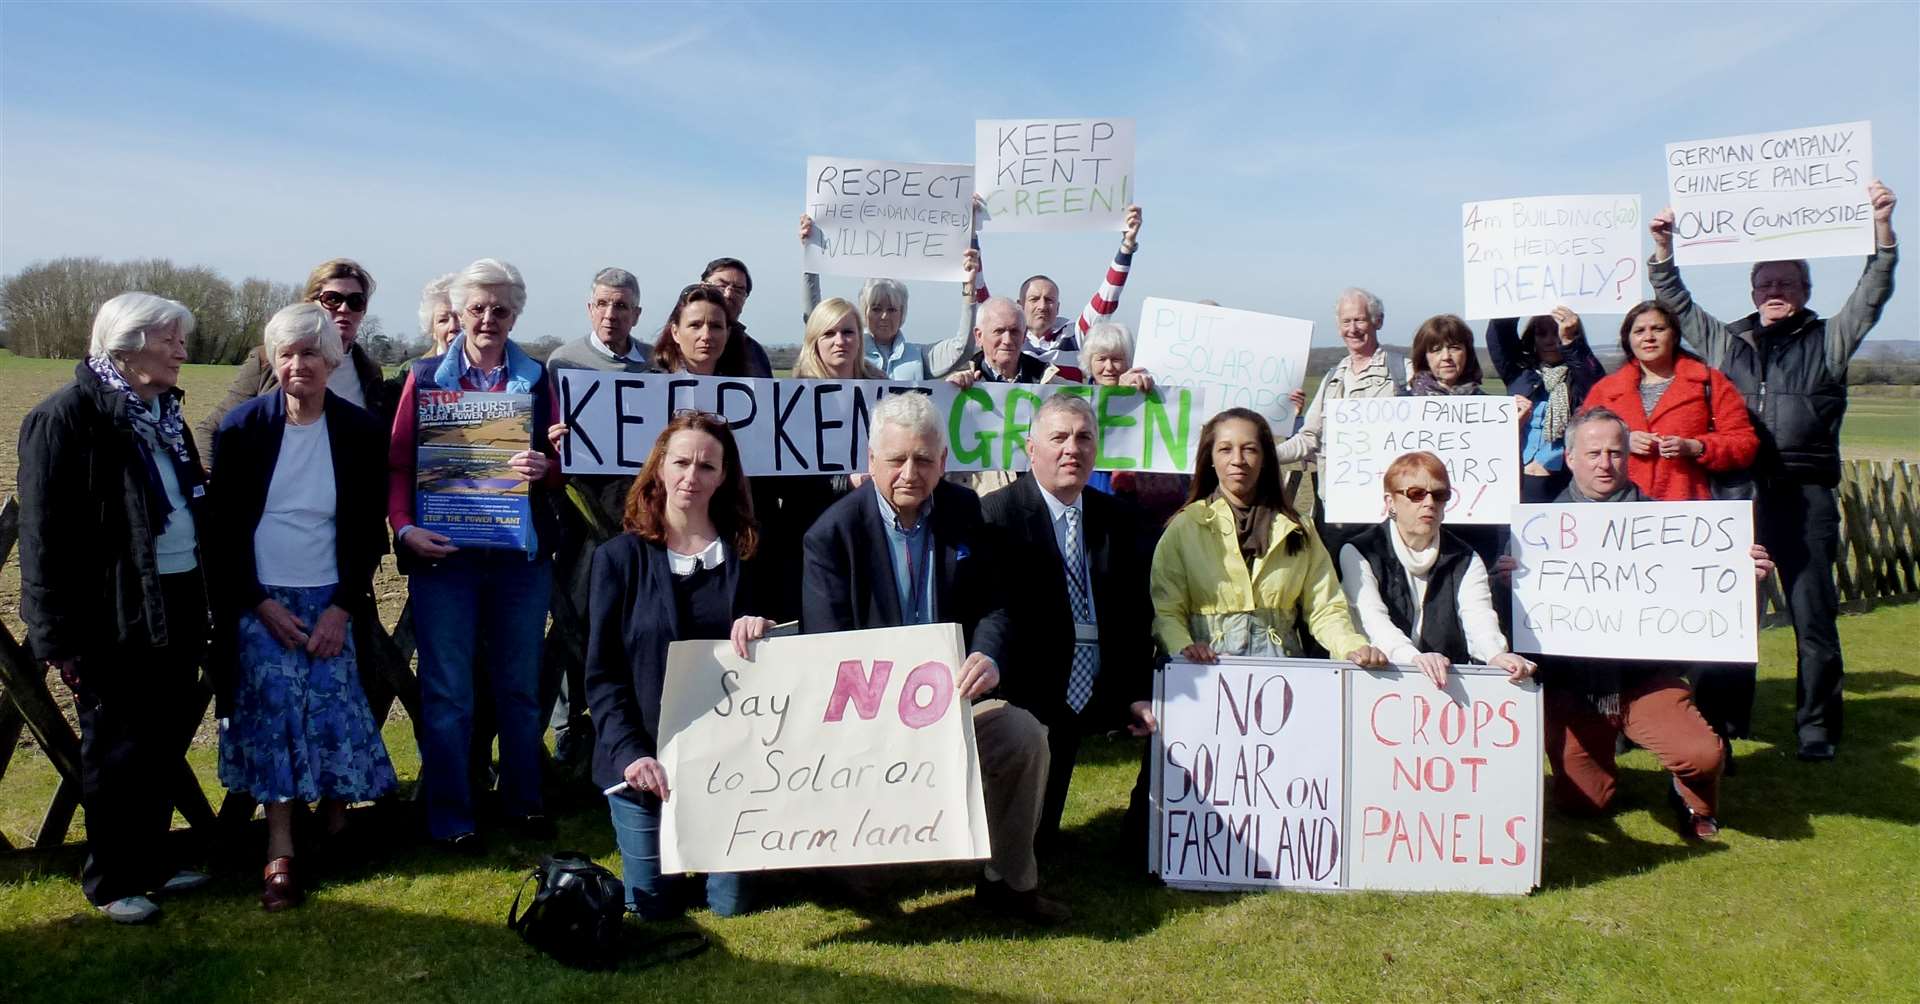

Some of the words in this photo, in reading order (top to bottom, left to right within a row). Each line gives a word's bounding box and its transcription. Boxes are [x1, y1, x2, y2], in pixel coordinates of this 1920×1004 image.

[998, 122, 1114, 156] KEEP
[1669, 144, 1753, 167] GERMAN
[816, 166, 971, 199] RESPECT
[997, 157, 1112, 186] KENT
[1674, 169, 1760, 193] CHINESE
[986, 176, 1128, 216] GREEN!
[810, 203, 853, 219] THE
[860, 200, 970, 232] (ENDANGERED)
[1464, 205, 1502, 231] 4m
[1678, 210, 1736, 240] OUR
[1743, 203, 1871, 236] COUNTRYSIDE
[820, 227, 948, 258] WILDLIFE
[1467, 242, 1503, 263] 2m
[1513, 237, 1606, 257] HEDGES
[1494, 257, 1637, 304] REALLY?
[1154, 308, 1224, 342] PUT
[1162, 343, 1254, 379] SOLAR
[1260, 355, 1296, 387] ON
[419, 400, 517, 415] STAPLEHURST
[420, 390, 464, 405] STOP
[452, 411, 483, 420] POWER
[487, 409, 516, 419] PLANT
[1422, 400, 1510, 424] PANELS
[772, 381, 933, 471] KEN
[949, 385, 1193, 471] GREN
[1336, 431, 1372, 457] 53
[1384, 431, 1471, 450] ACRES
[1601, 514, 1735, 552] NEEDS
[1538, 560, 1664, 594] FARMS
[1691, 565, 1738, 594] TO
[1523, 602, 1624, 633] GROW
[1638, 600, 1744, 639] FOOD!
[713, 670, 791, 746] Say
[822, 660, 955, 729] NO
[1215, 672, 1294, 736] NO
[1370, 692, 1521, 748] CROPS
[707, 761, 744, 794] to
[750, 750, 874, 794] Solar
[885, 761, 936, 787] on
[1166, 741, 1280, 810] SOLAR
[1286, 777, 1328, 810] ON
[1392, 756, 1488, 792] NOT
[1166, 809, 1339, 881] FARMLAND
[1361, 806, 1527, 867] PANELS
